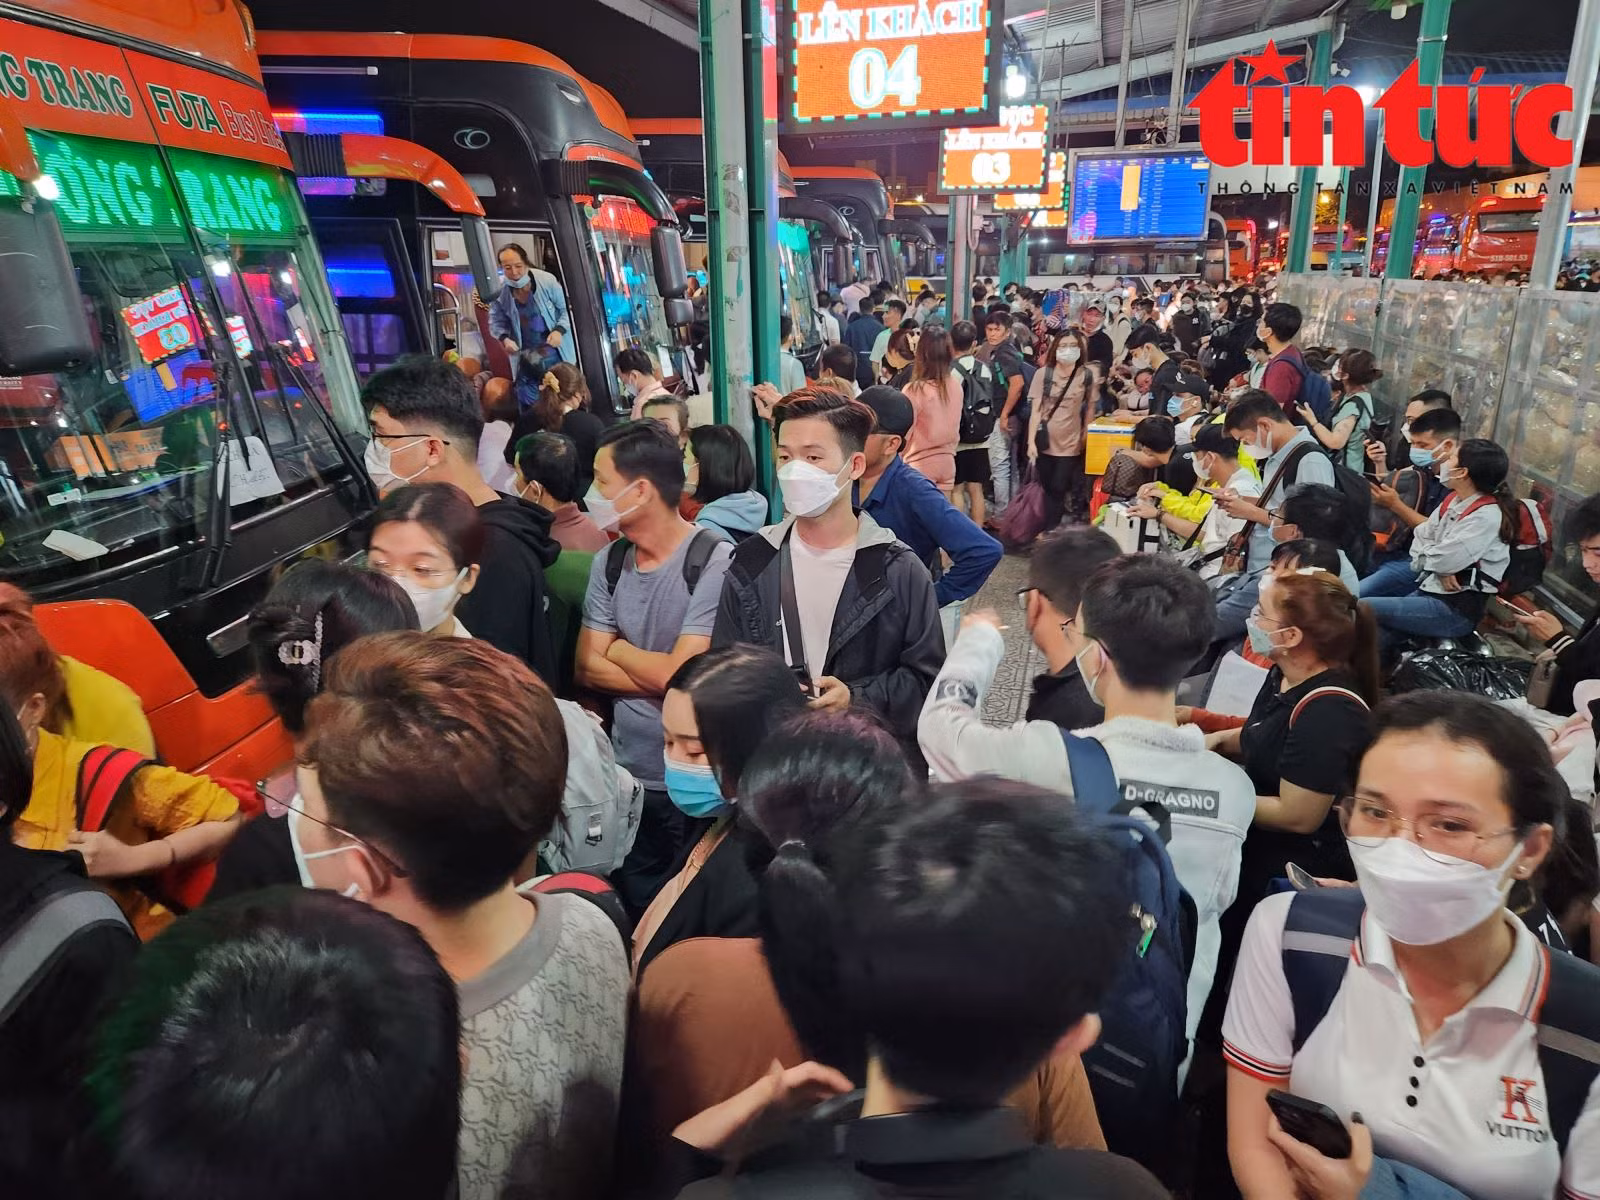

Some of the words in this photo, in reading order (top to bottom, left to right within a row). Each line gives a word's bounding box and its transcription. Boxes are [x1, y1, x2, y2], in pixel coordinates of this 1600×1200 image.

[799, 1, 864, 45] LÊN
[865, 0, 984, 40] KHÁCH
[25, 57, 133, 119] TRANG
[848, 44, 922, 109] 04
[146, 82, 227, 136] FUTA
[219, 100, 257, 143] Bus
[151, 164, 283, 233] RANG
[972, 152, 1012, 185] 03
[1125, 784, 1216, 811] D-GRAGNO
